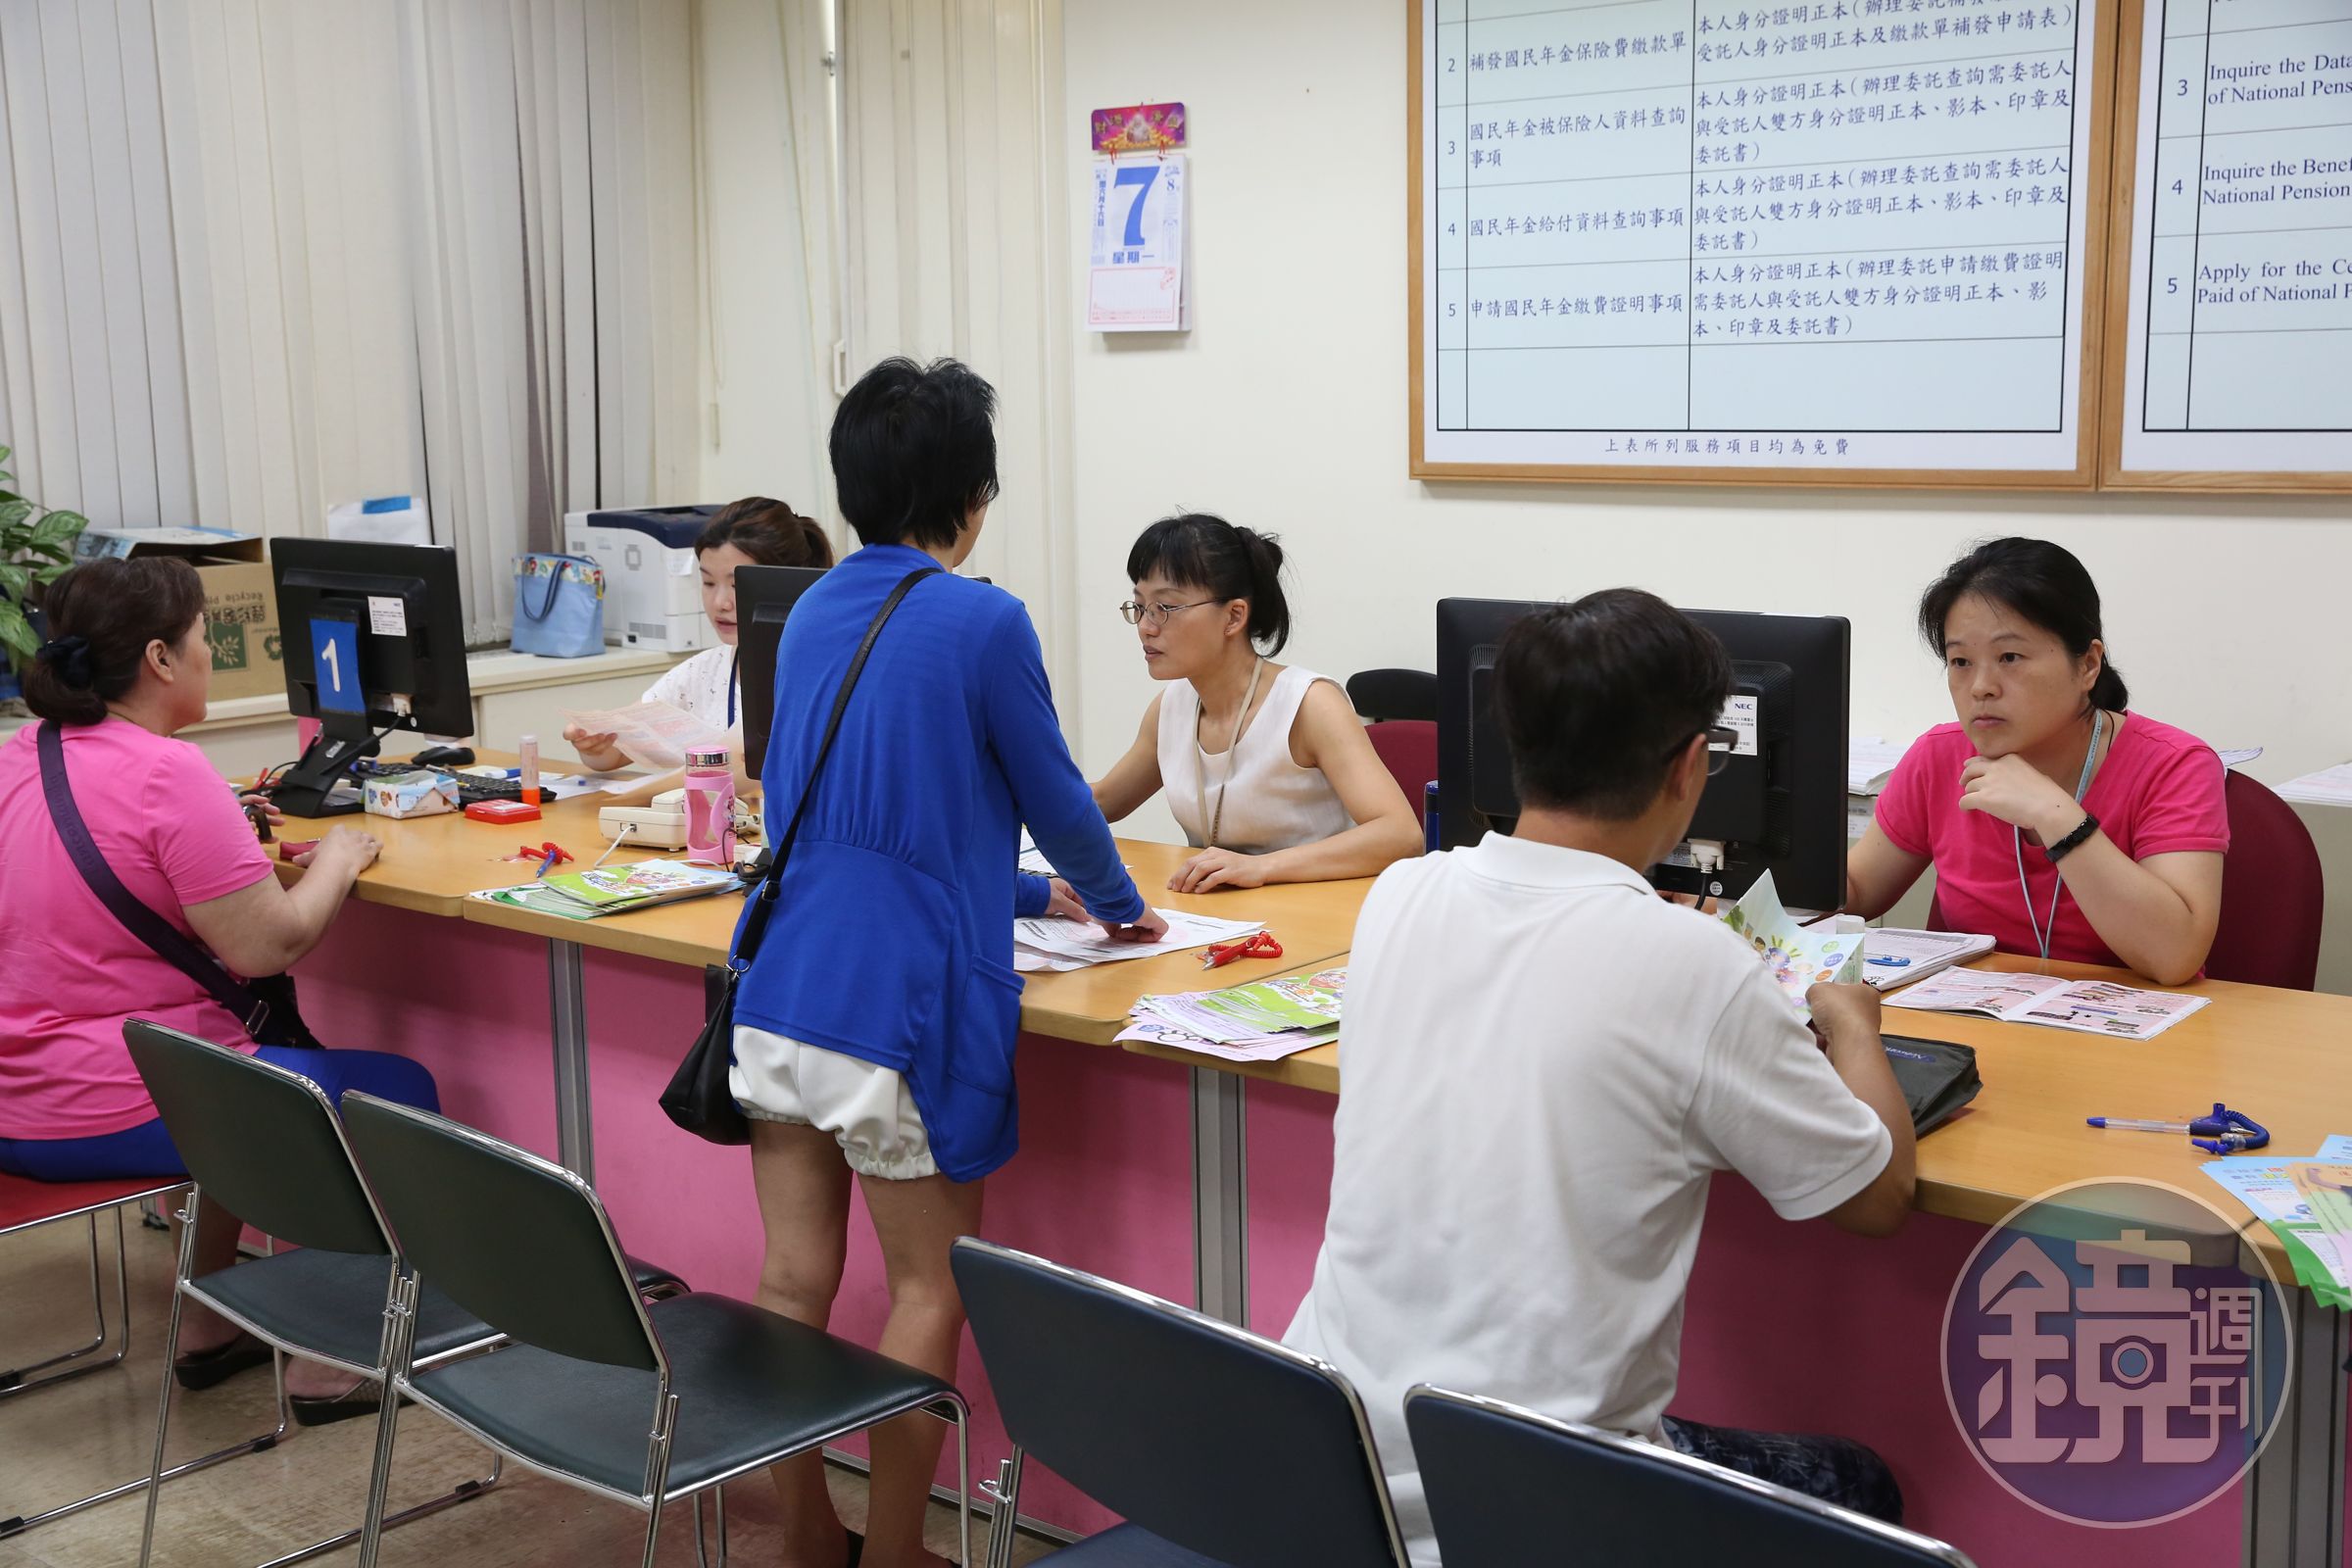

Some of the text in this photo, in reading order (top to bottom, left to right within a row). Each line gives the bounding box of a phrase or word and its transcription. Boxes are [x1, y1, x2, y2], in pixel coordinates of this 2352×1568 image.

[1470, 30, 1687, 72] 補發國民年金保險費繳款單
[1447, 58, 1456, 73] 2
[2210, 62, 2272, 82] Inquire
[2279, 56, 2306, 74] the
[2177, 79, 2188, 96] 3
[2208, 87, 2229, 105] of
[2231, 82, 2305, 103] National
[1470, 107, 1686, 140] 國民年金被保險人資料查詢
[1447, 140, 1456, 156] 3
[1470, 149, 1501, 169] 事項
[2205, 162, 2265, 183] Inquire
[2271, 159, 2297, 177] the
[2172, 179, 2183, 195] 4
[2202, 181, 2350, 205] National Pension
[1113, 166, 1160, 246] 7
[1447, 222, 1456, 236] 4
[1470, 207, 1684, 236] 國民年金給付資料查詢事項
[1113, 251, 1154, 264] 星期一
[2198, 264, 2251, 282] Apply
[2261, 261, 2286, 277] for
[2296, 260, 2322, 275] the
[2167, 277, 2179, 294] 5
[2197, 286, 2233, 304] Paid
[2239, 286, 2260, 302] of
[2263, 283, 2336, 302] National
[1447, 303, 1456, 318] 5
[1471, 293, 1683, 318] 申請國民年金繳費證明事項
[1604, 437, 1849, 456] 上表所列服務項目均為免費
[321, 638, 341, 692] 1
